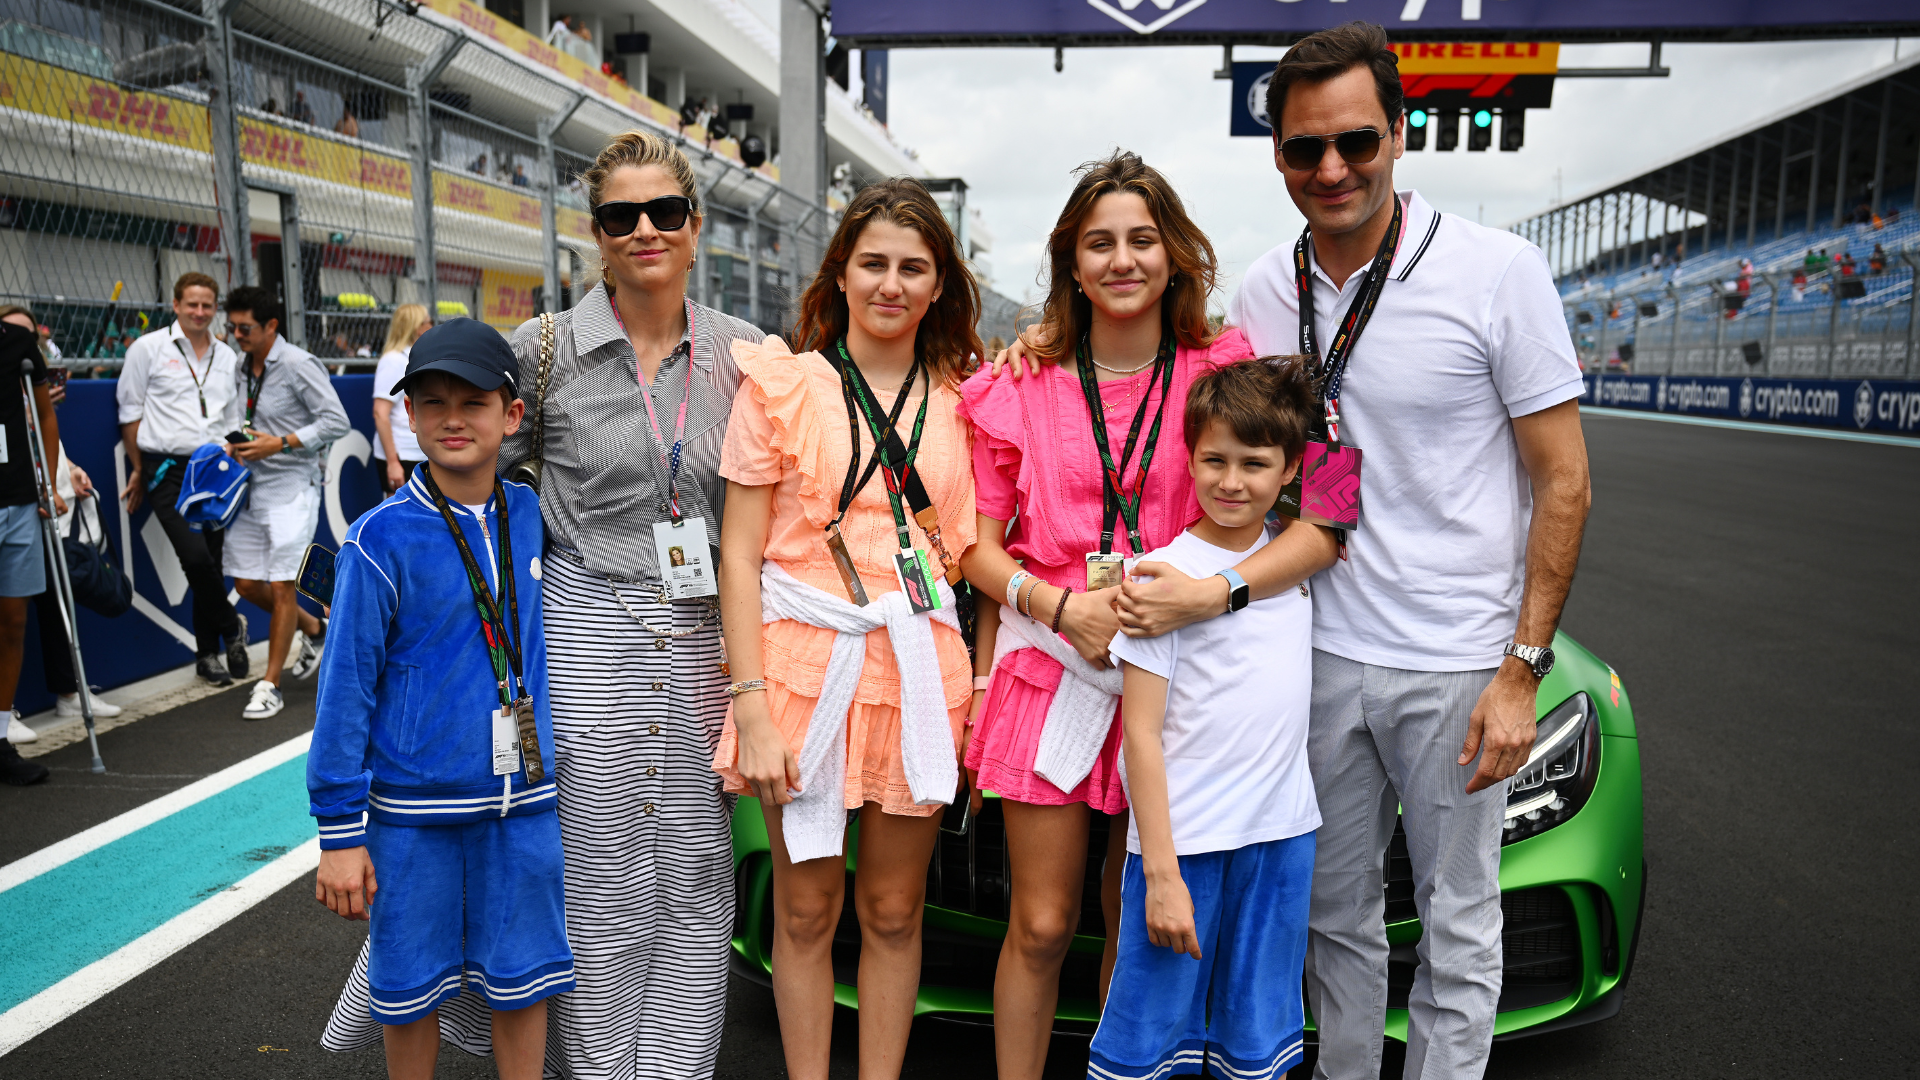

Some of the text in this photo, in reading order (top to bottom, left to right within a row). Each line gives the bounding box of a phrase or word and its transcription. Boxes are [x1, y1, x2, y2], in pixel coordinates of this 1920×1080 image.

[1386, 42, 1540, 58] IRELLI
[88, 83, 175, 136] DHL
[243, 126, 307, 167] DHL
[498, 286, 533, 318] DH
[857, 388, 872, 419] PADDOCK
[1668, 380, 1731, 412] crypto.com
[1754, 382, 1839, 420] crypto.com
[1306, 474, 1360, 520] VIP
[919, 554, 936, 590] PADDOCK
